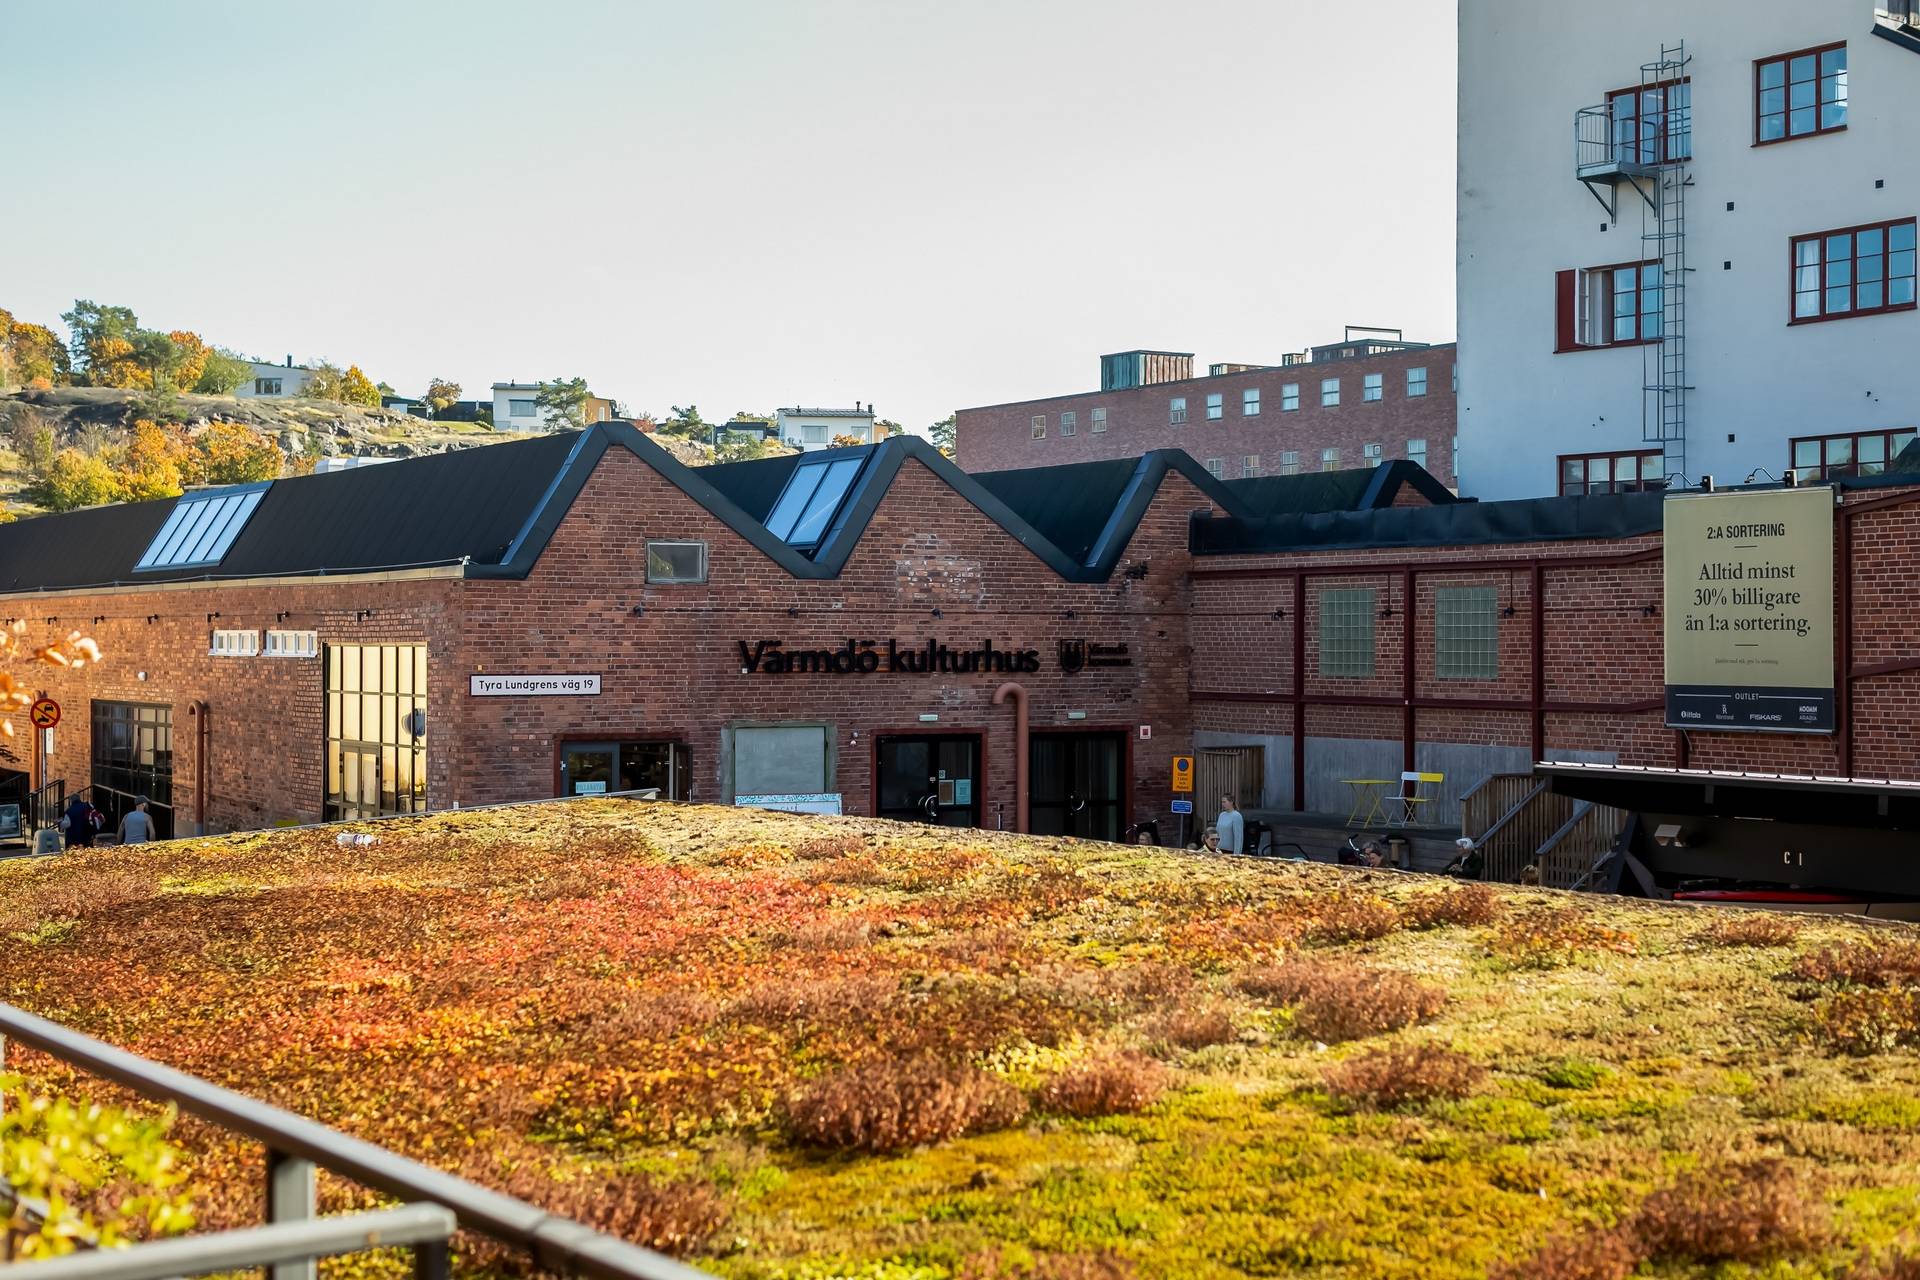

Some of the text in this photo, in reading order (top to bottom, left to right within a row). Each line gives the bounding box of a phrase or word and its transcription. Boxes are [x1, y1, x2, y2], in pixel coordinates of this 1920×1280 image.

[1707, 523, 1785, 539] 2:A SORTERING
[1698, 561, 1796, 580] Alltid minst
[1693, 587, 1801, 611] 30% billigare
[1685, 613, 1811, 637] än 1:a sortering.
[738, 638, 1040, 674] Värmdö kulturhus
[479, 679, 594, 691] Tyra Lundgrens väg 19
[1735, 692, 1760, 700] OUTLET
